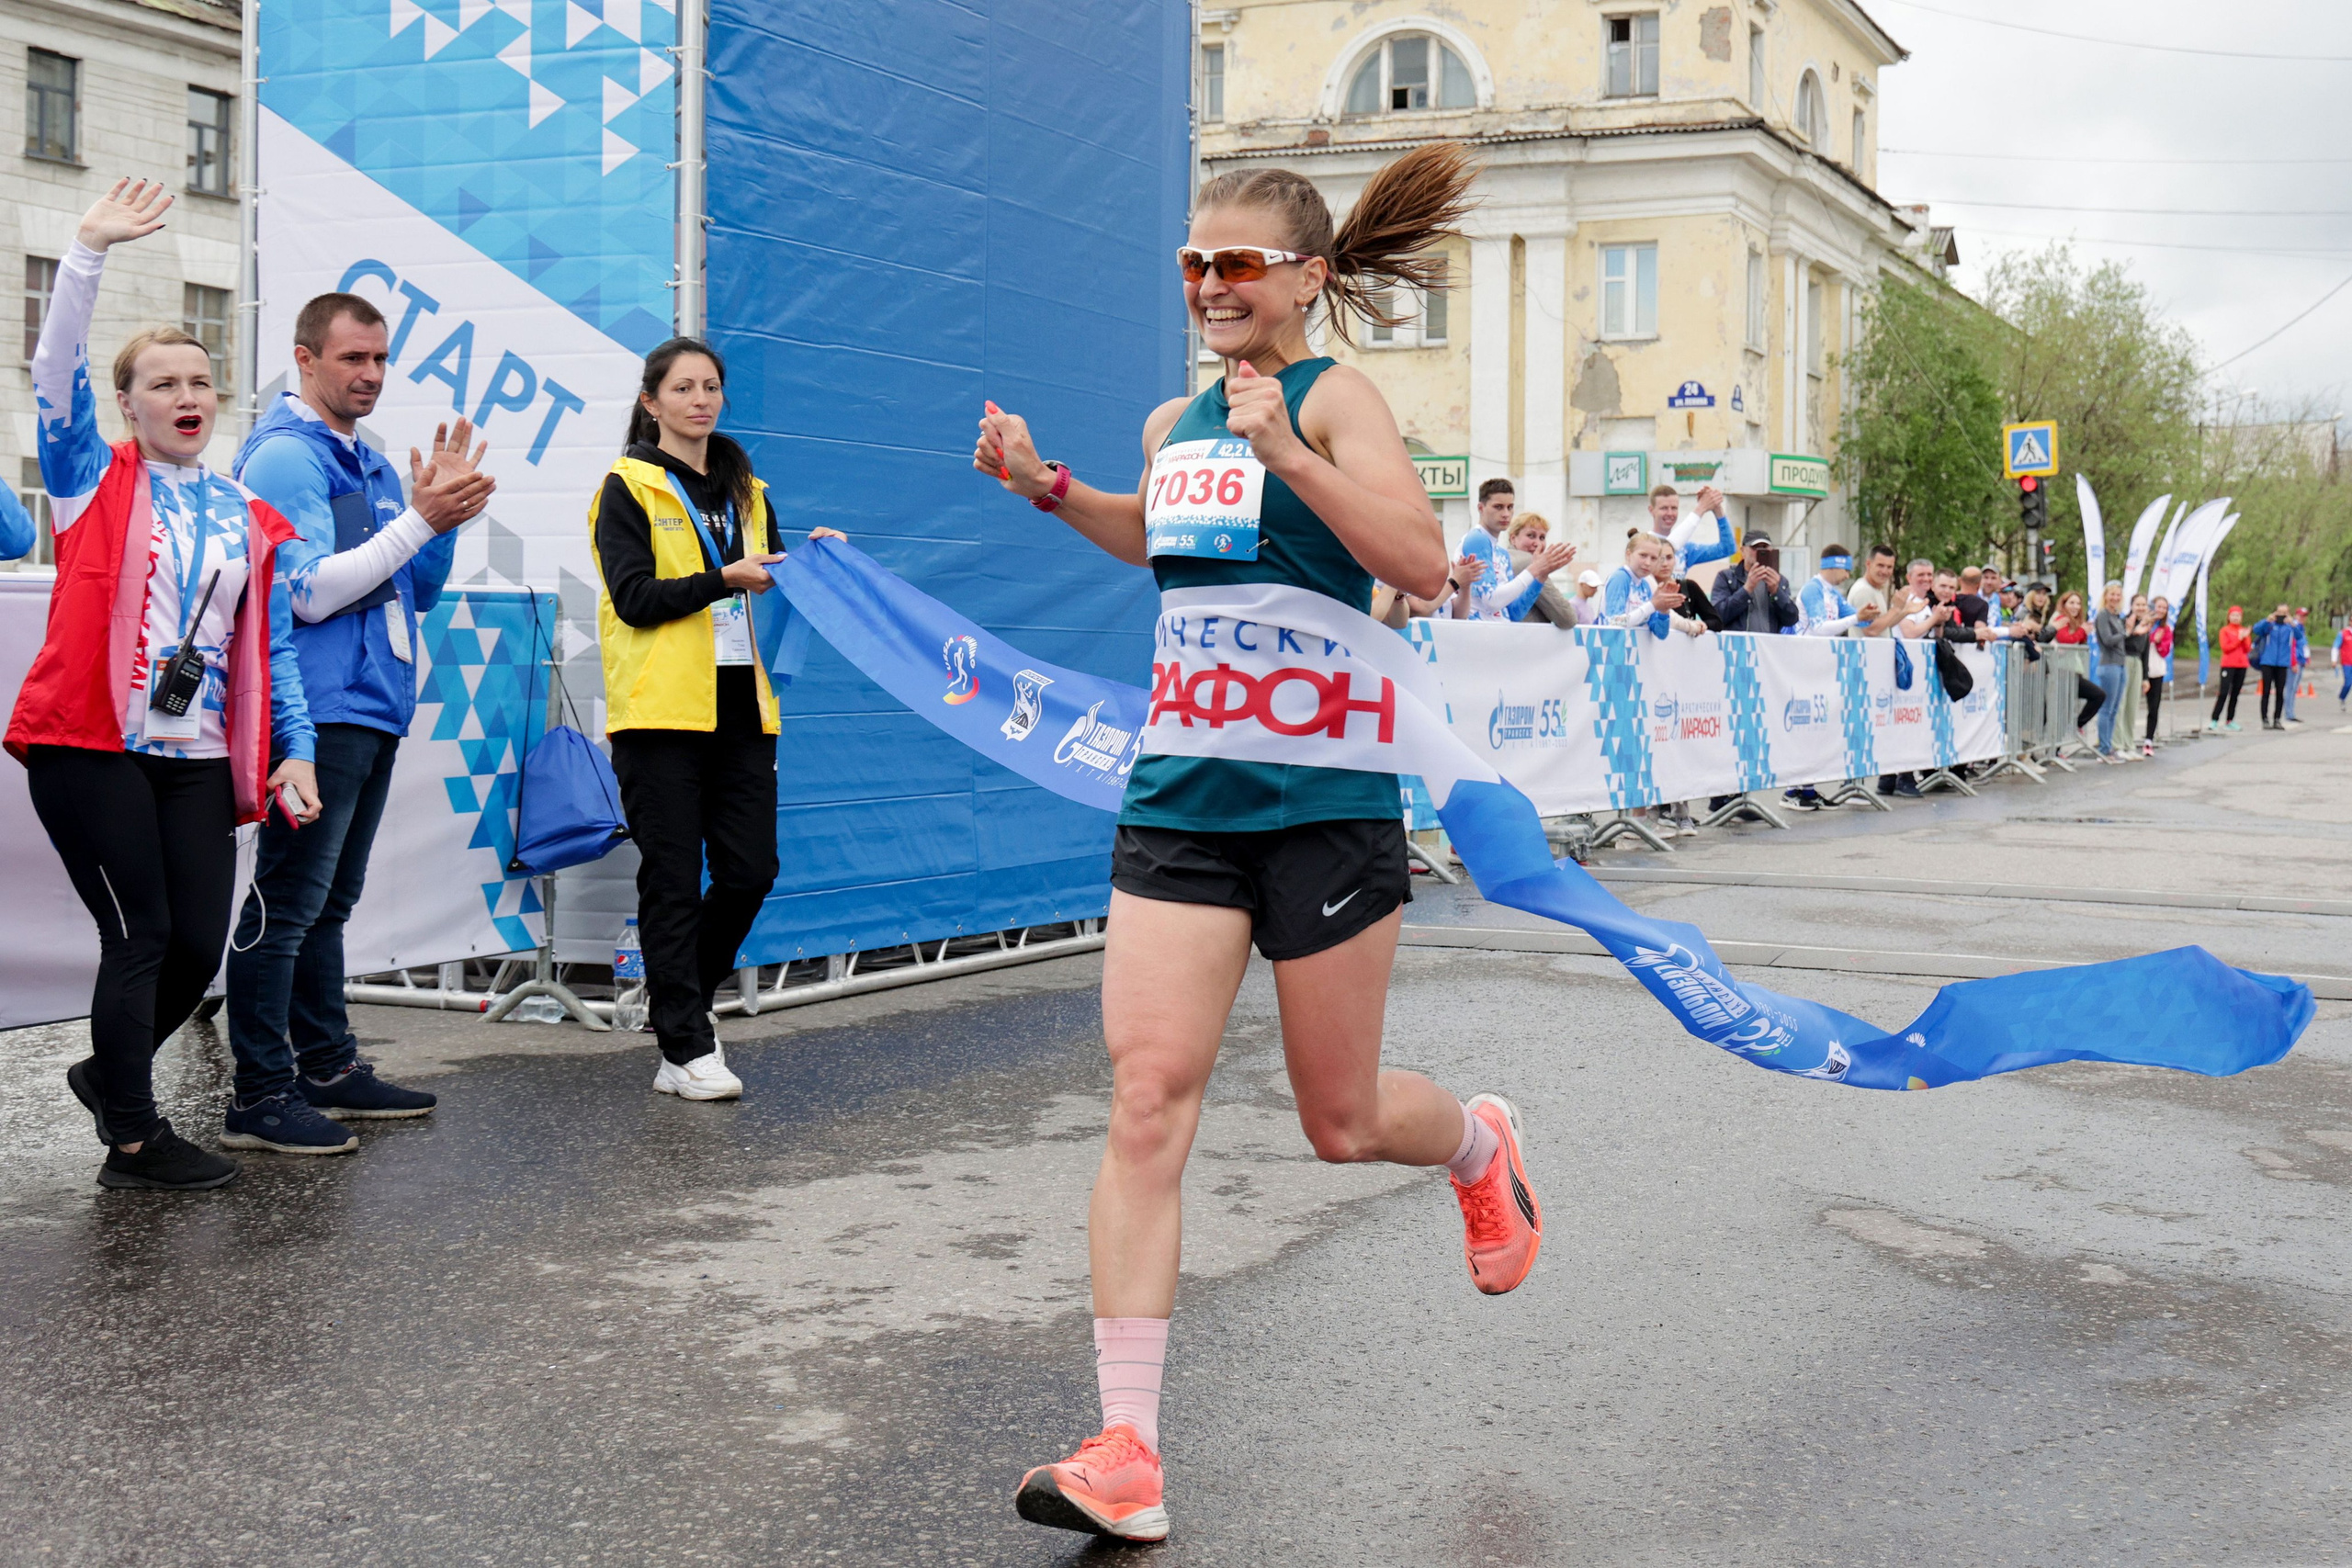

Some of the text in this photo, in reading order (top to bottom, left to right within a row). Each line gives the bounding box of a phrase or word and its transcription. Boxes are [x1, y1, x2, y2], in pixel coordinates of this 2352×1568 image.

[336, 258, 586, 467] СТАРТ
[1684, 382, 1700, 396] 24
[1218, 443, 1244, 458] 42,2
[1151, 468, 1245, 512] 7036
[1505, 699, 1561, 738] ГАЗПРОМ 55
[1680, 716, 1721, 740] МАРАФОН
[1086, 721, 1132, 756] ГАЗПРОМ
[1078, 748, 1114, 769] ТРАНСГАЗ
